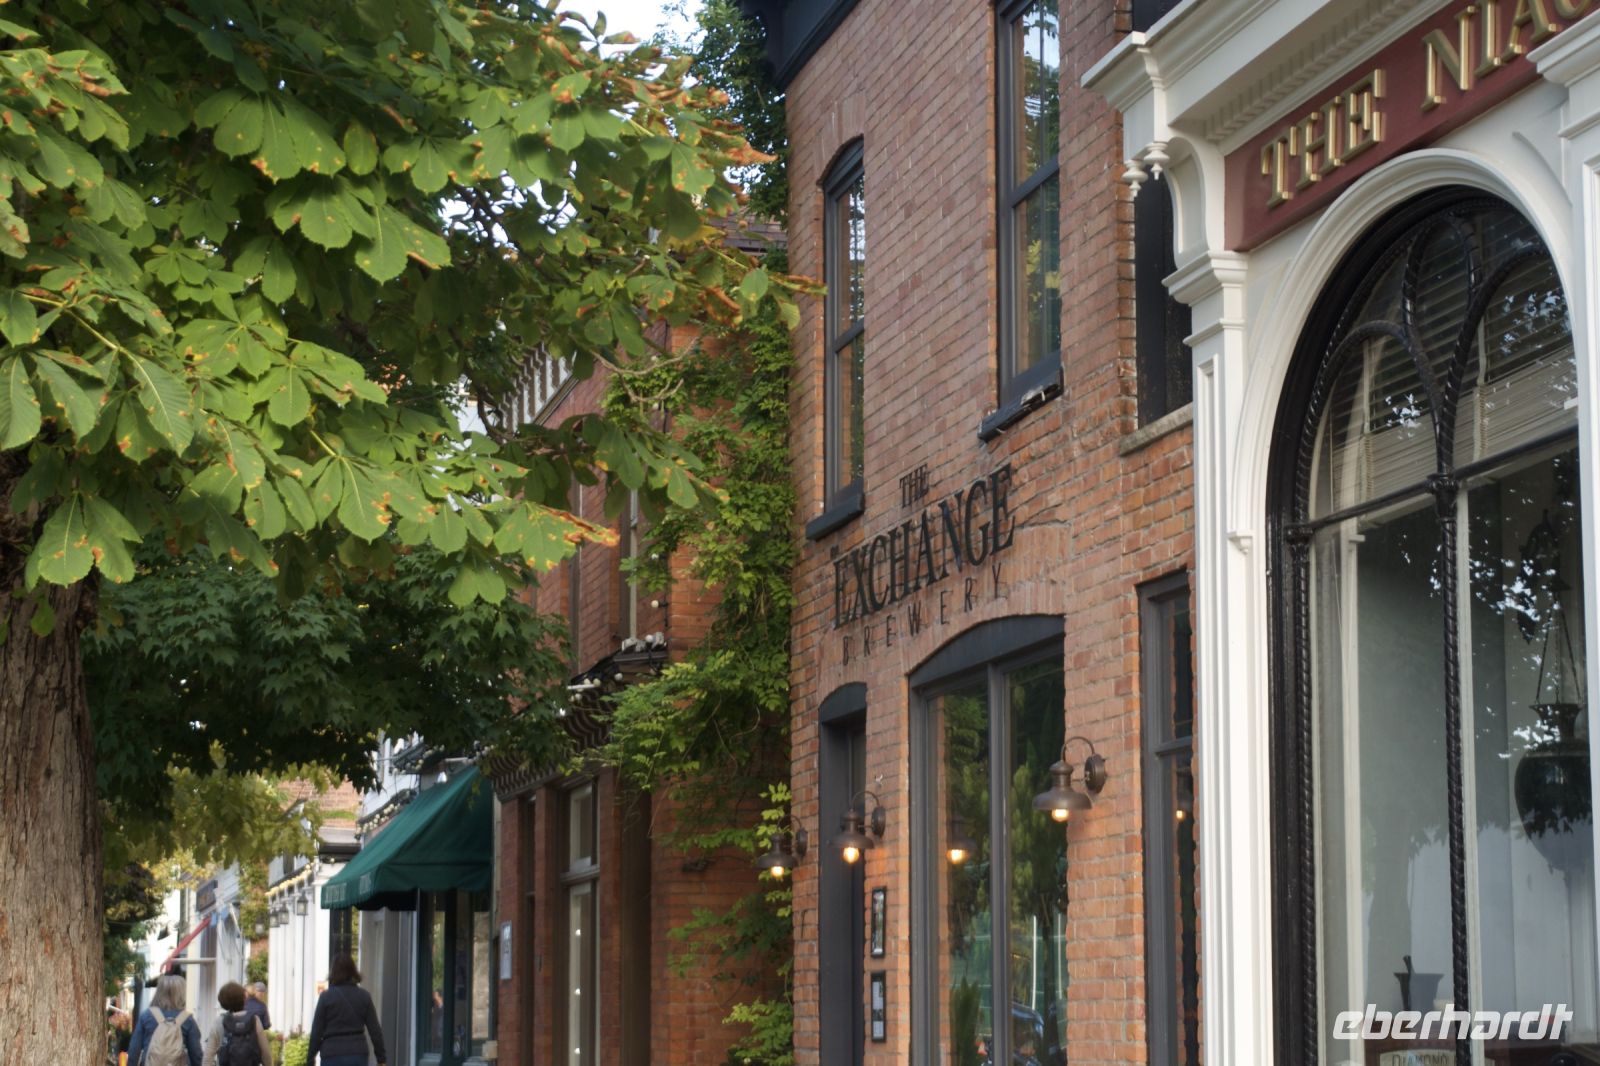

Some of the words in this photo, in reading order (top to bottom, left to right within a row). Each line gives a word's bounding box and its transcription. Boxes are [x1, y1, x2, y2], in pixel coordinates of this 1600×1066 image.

[1261, 69, 1382, 207] THE
[1421, 0, 1591, 112] NIA
[833, 463, 1015, 630] EXCHANGE
[900, 463, 929, 508] THE
[842, 562, 1004, 667] BREWERY
